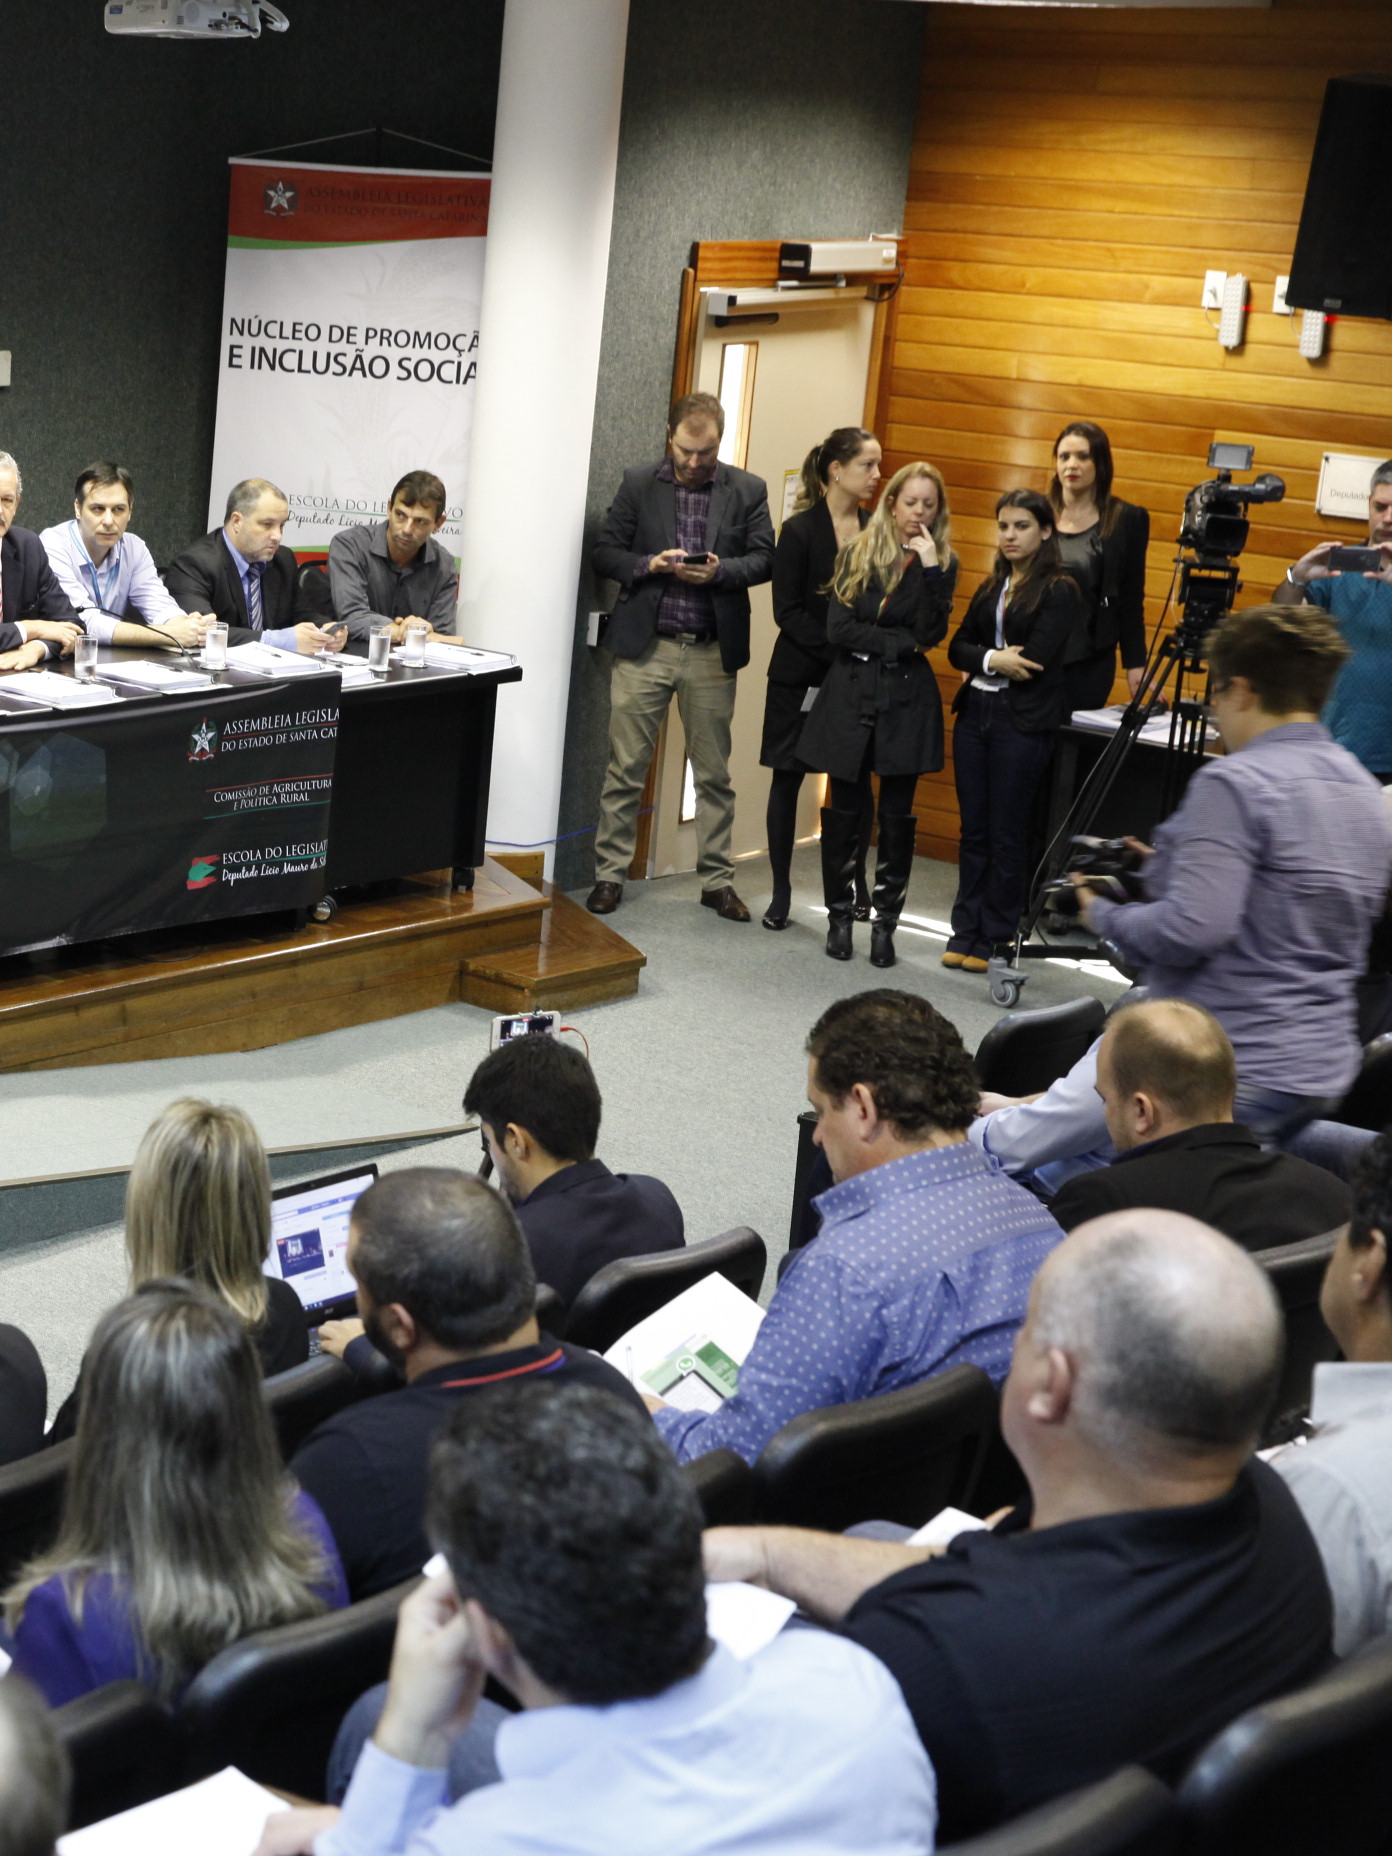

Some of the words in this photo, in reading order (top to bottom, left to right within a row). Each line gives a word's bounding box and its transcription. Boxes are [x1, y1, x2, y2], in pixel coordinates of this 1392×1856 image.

[228, 314, 322, 342] NÚCLEO
[327, 325, 358, 345] DE
[227, 344, 243, 369] E
[249, 347, 391, 379] INCLUSÃO
[289, 494, 341, 510] ESCOLA
[345, 499, 368, 512] DO
[223, 713, 292, 736] ASSEMBLEIA
[295, 707, 340, 726] LEGISLA
[221, 740, 236, 752] DO
[238, 735, 273, 750] ESTADO
[276, 732, 288, 745] DE
[289, 729, 318, 743] SANTA
[222, 849, 262, 865] ESCOLA
[265, 846, 283, 860] DO
